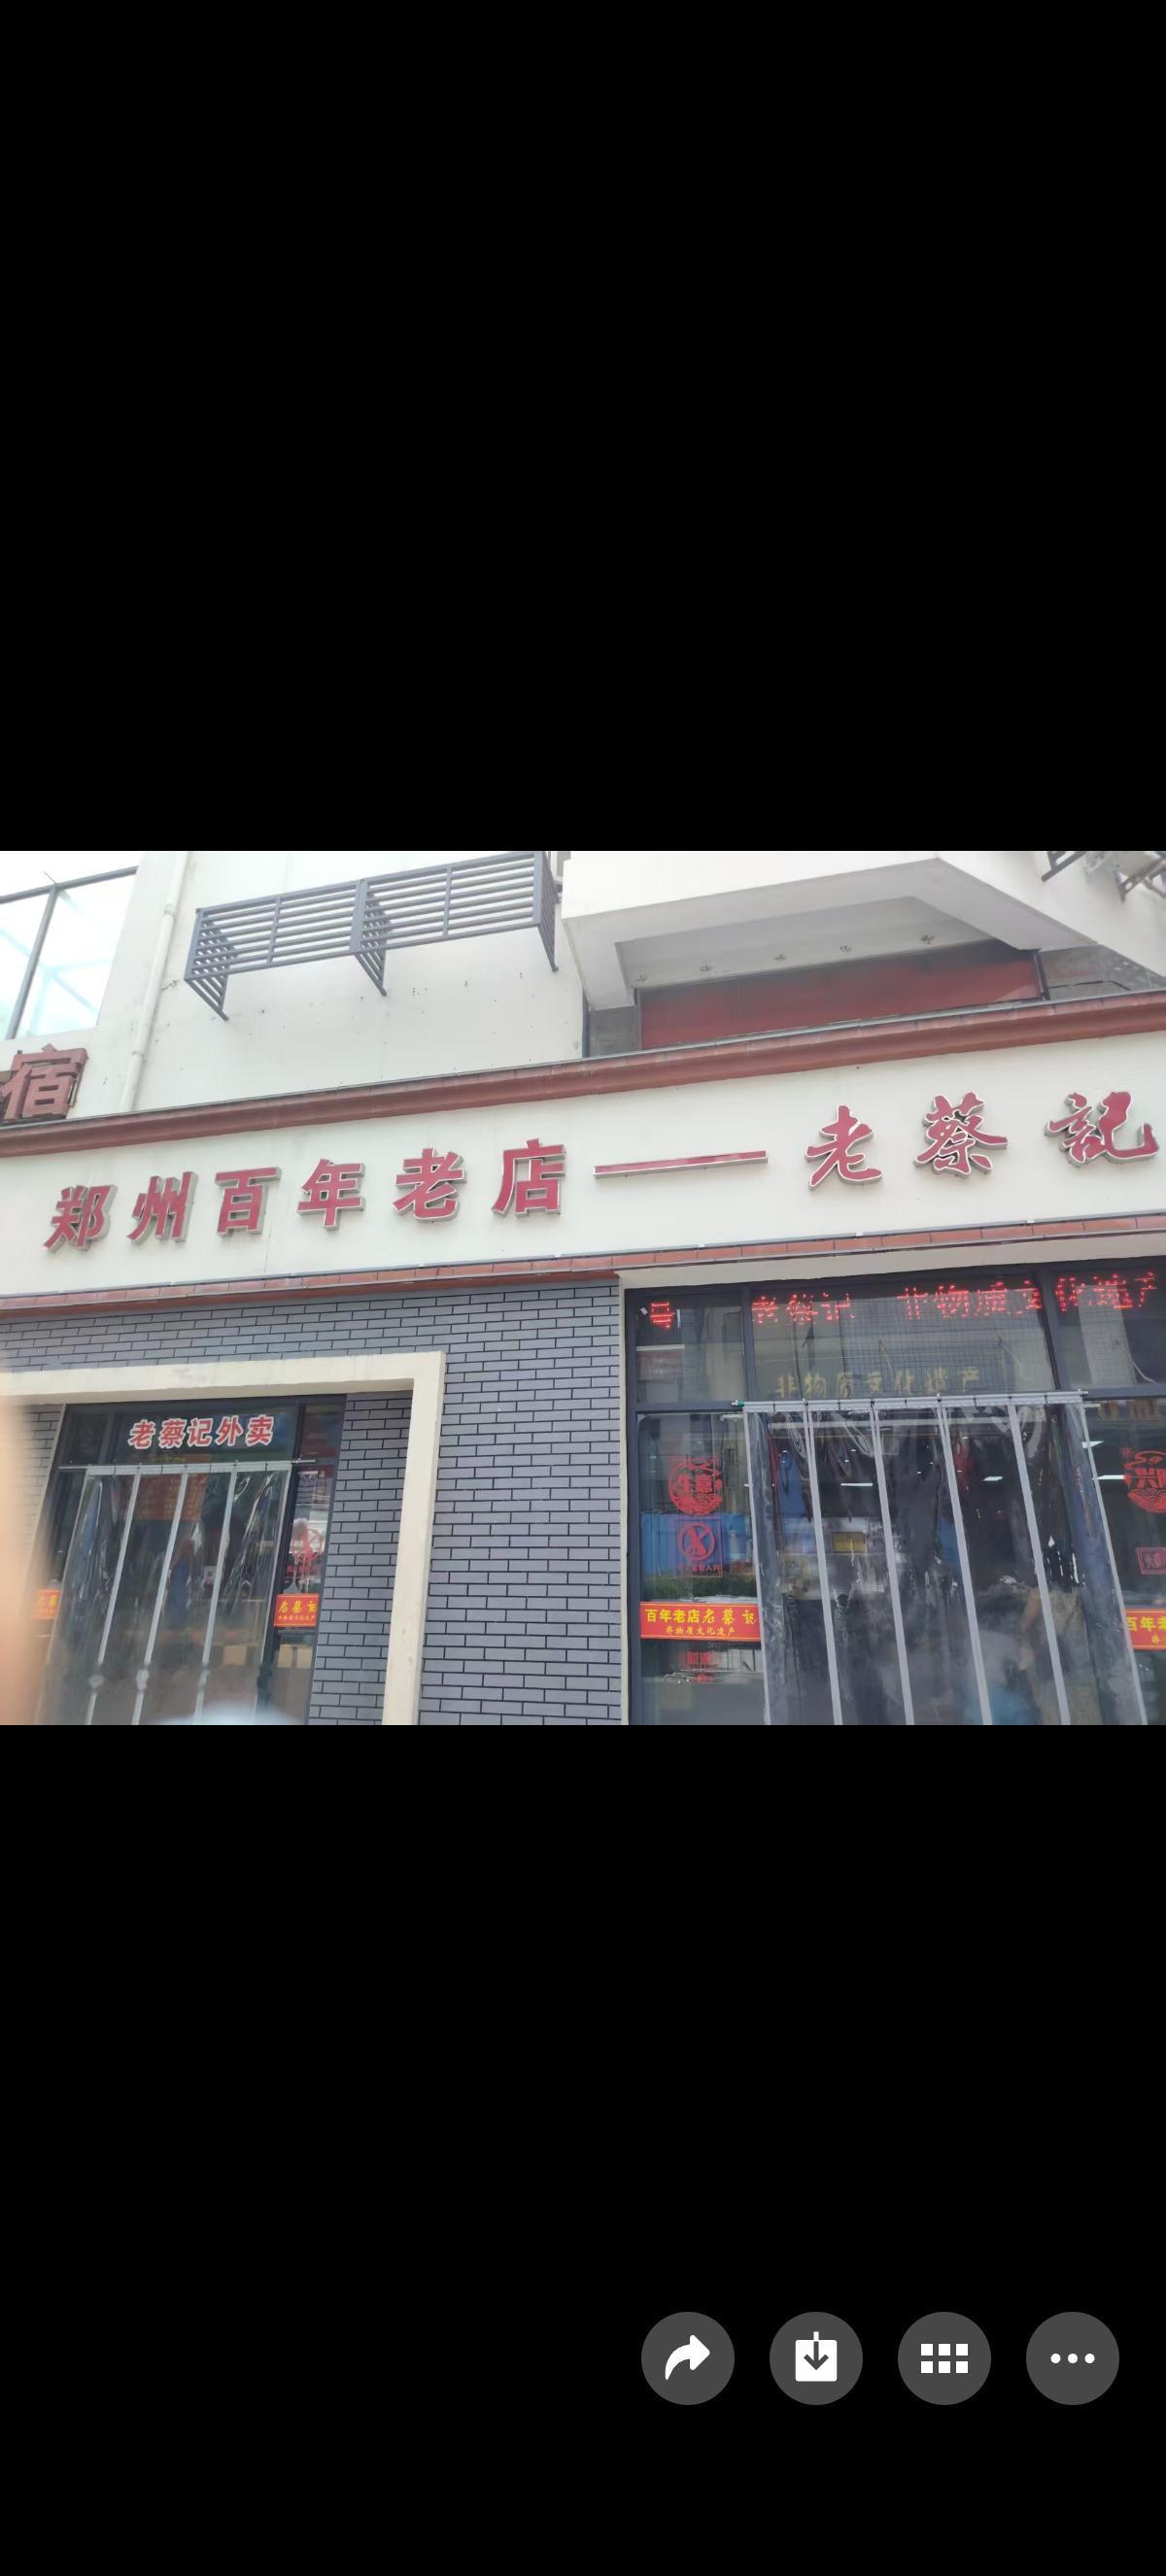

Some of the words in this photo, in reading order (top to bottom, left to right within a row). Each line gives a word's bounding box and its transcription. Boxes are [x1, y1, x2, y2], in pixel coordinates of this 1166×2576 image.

[0, 1042, 88, 1121] 宿
[127, 1413, 275, 1449] 老蔡记外卖
